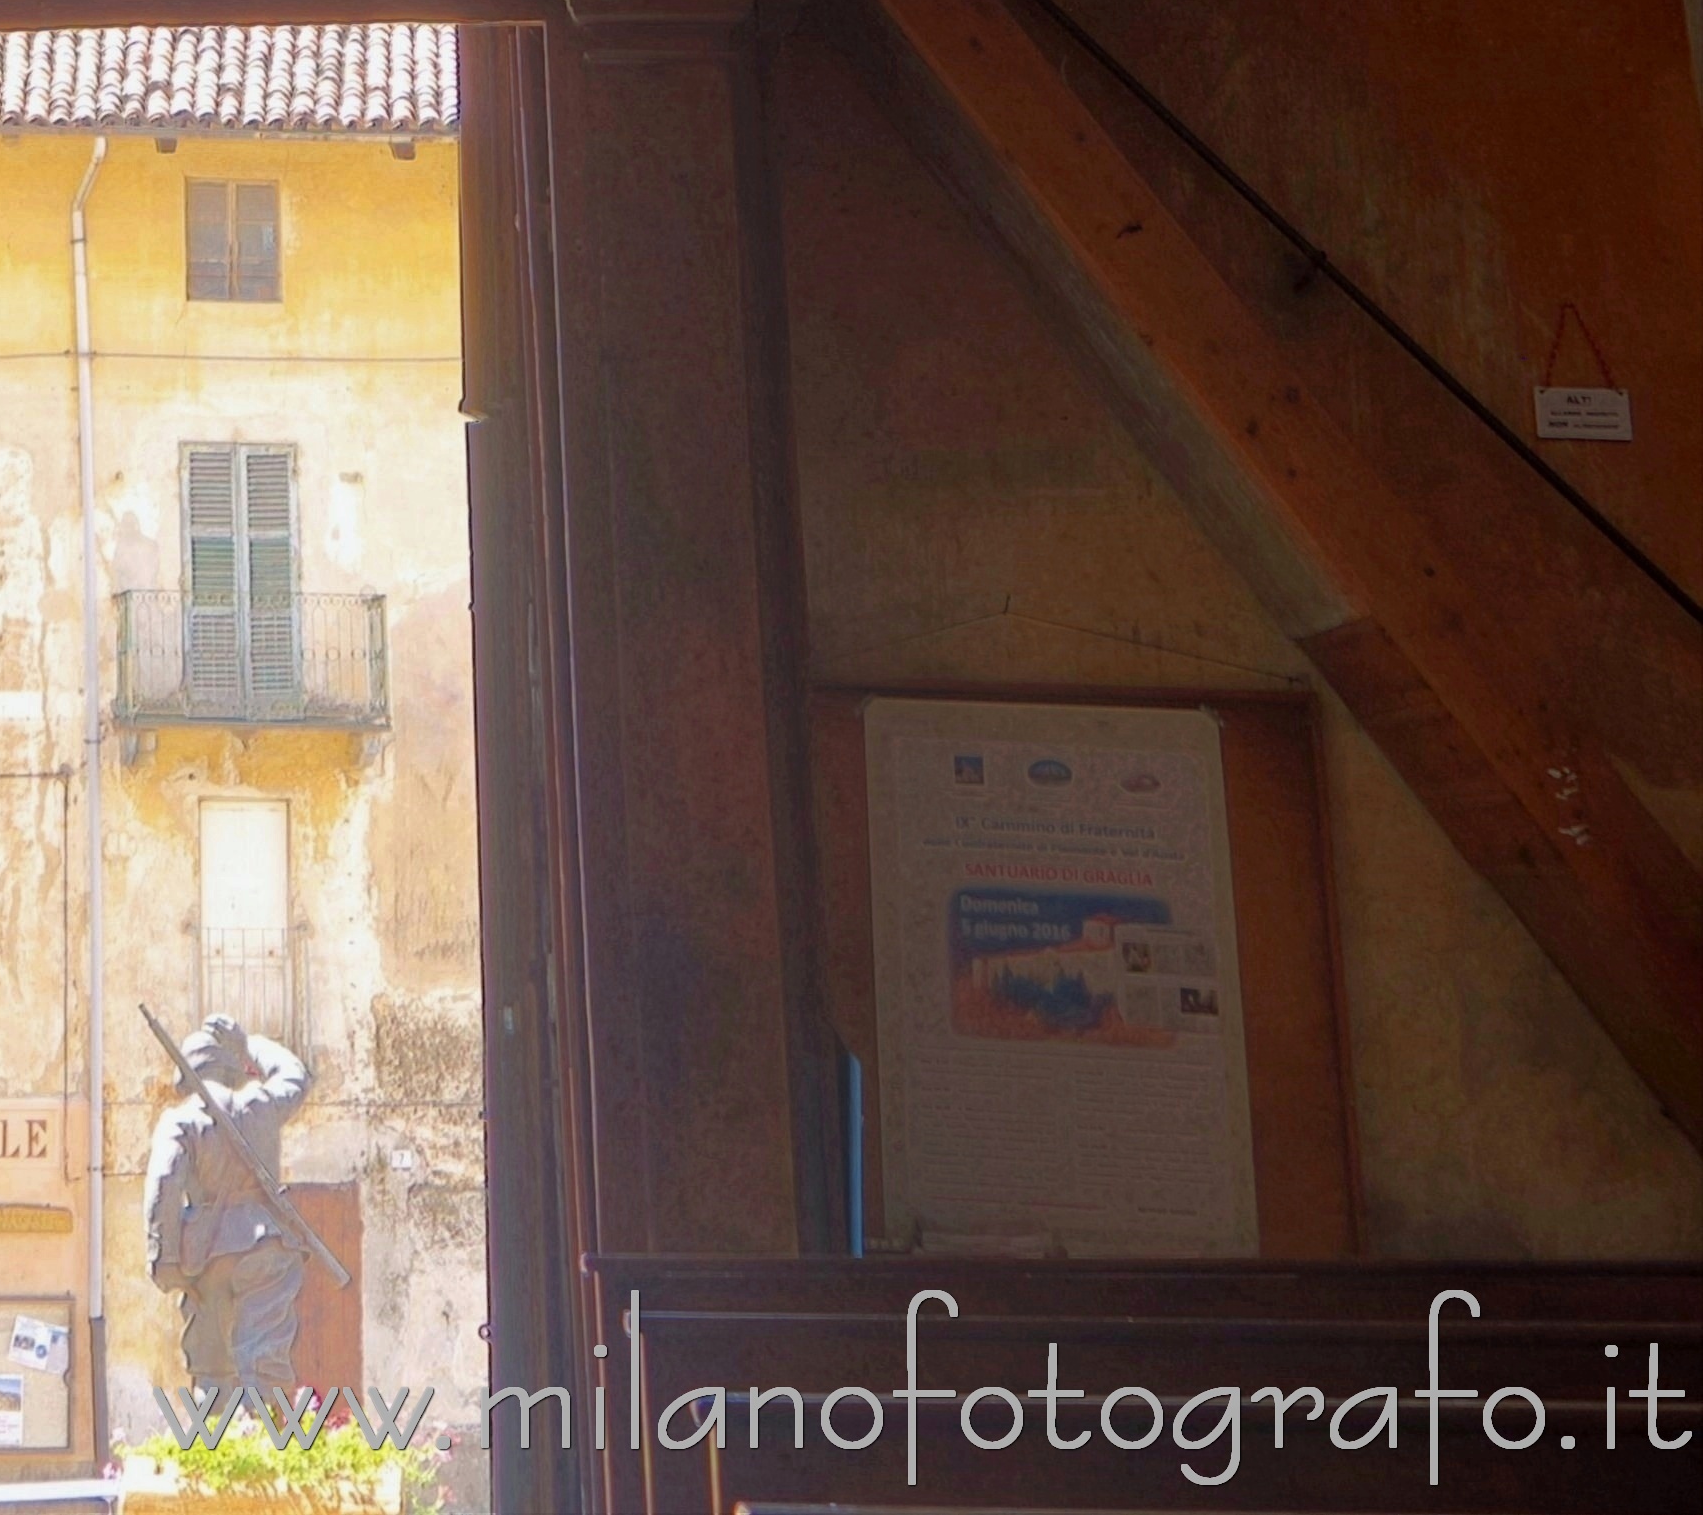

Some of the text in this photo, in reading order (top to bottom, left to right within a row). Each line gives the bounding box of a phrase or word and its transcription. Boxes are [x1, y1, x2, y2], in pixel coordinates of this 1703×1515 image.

[980, 817, 1056, 834] Cammino
[1060, 821, 1075, 834] di
[1079, 823, 1156, 840] Fraternità
[964, 862, 1154, 886] SANTUARIO DI GRAGLIA
[960, 894, 1039, 915] Domenica
[975, 919, 1029, 941] giugno
[1033, 921, 1071, 941] 2016
